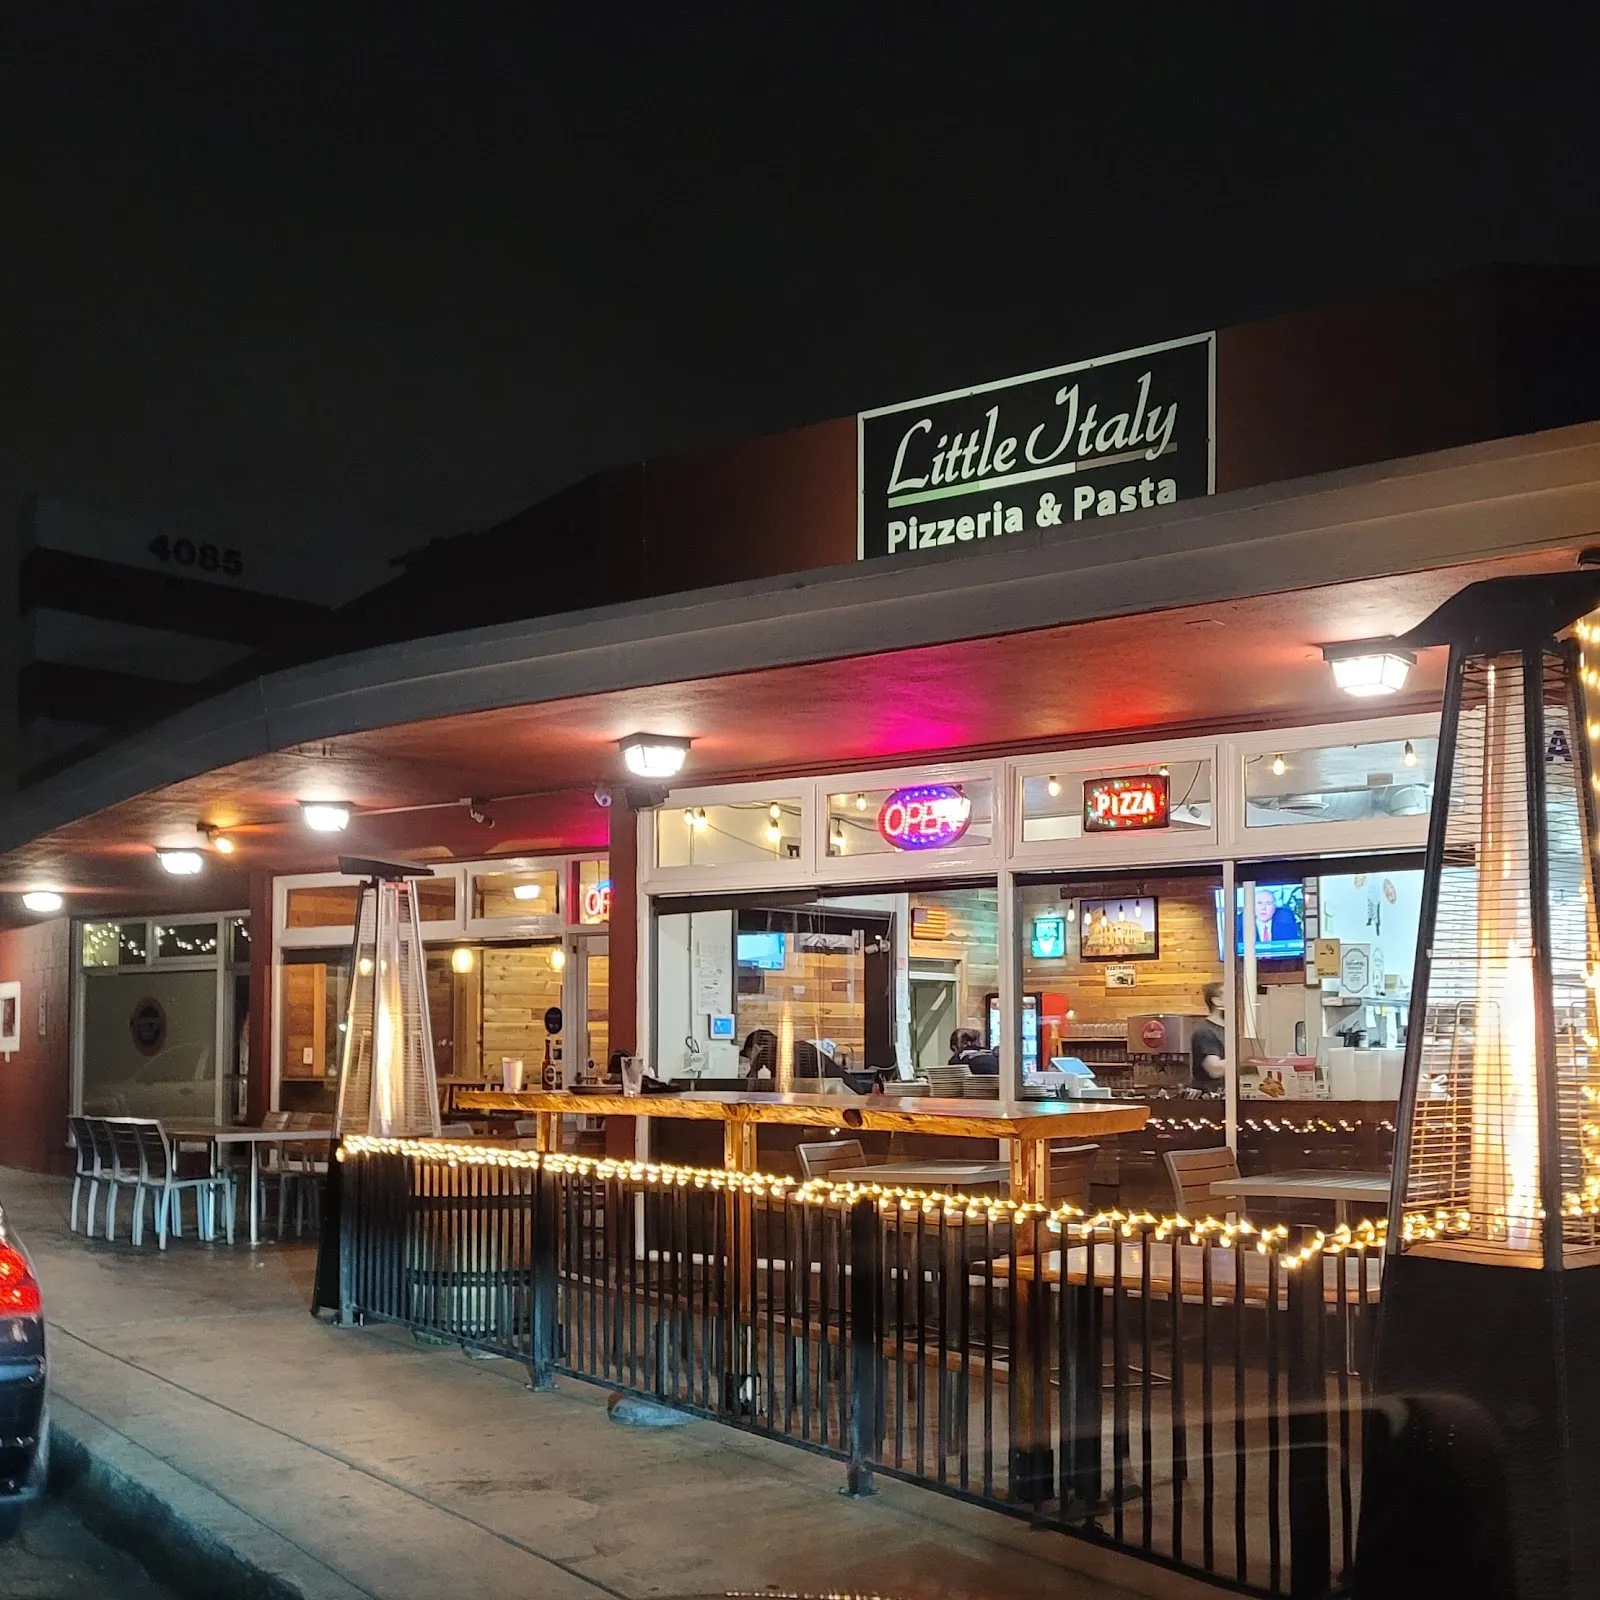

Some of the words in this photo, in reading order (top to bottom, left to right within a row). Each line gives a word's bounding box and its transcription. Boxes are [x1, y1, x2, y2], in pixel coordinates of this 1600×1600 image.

[886, 404, 1018, 495] Little
[1024, 371, 1178, 464] Italy
[887, 501, 1024, 554] Pizzeria
[1035, 492, 1063, 528] &
[1074, 476, 1177, 521] Pasta
[148, 534, 244, 576] 4085
[1097, 790, 1156, 817] PIZZA
